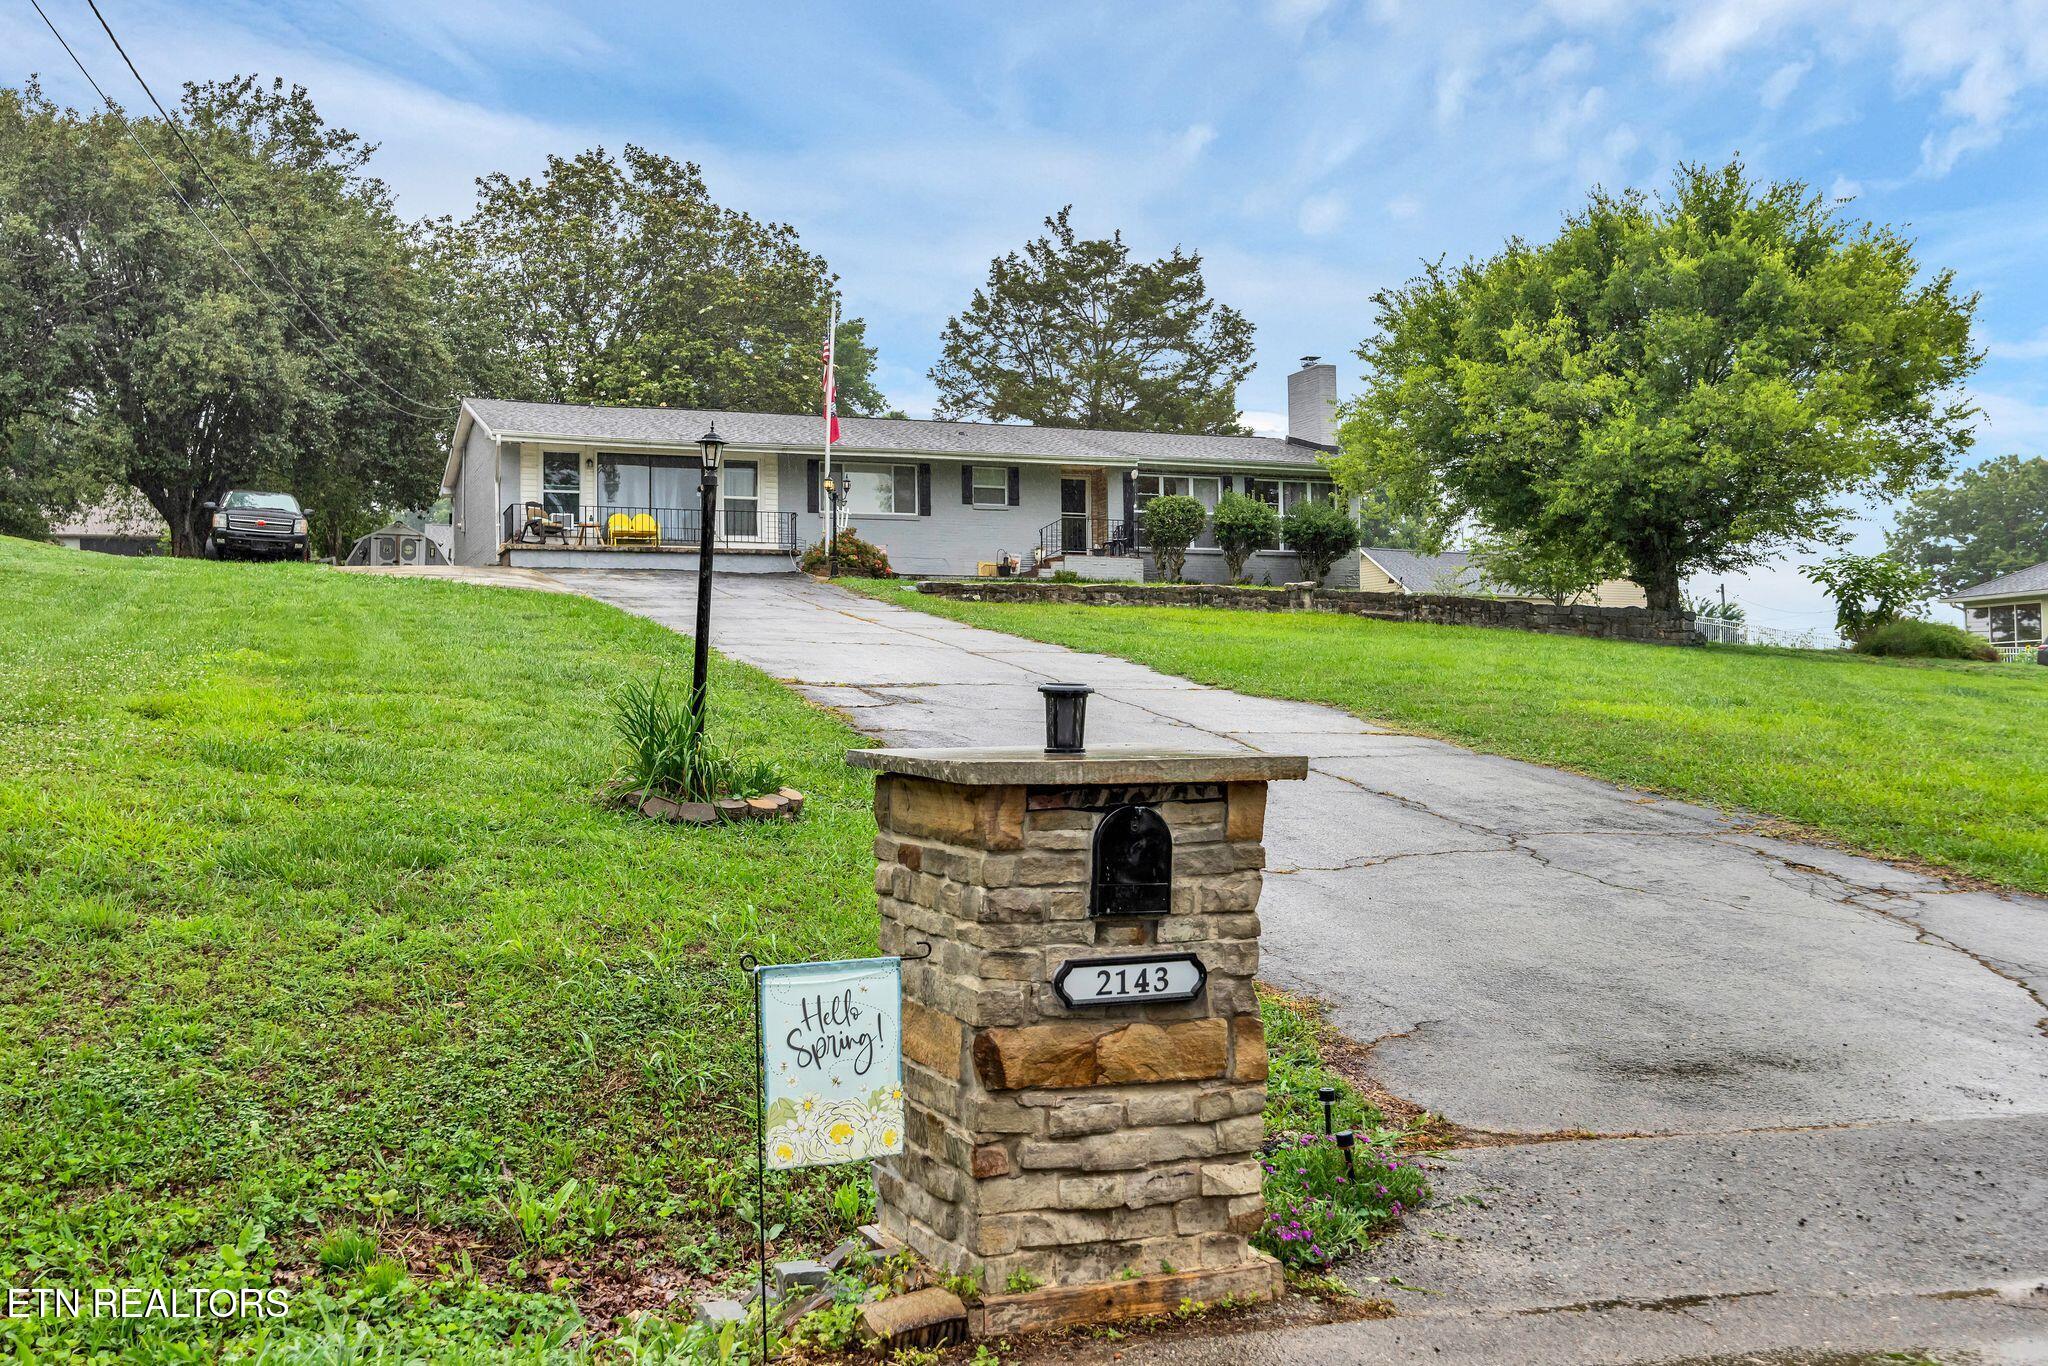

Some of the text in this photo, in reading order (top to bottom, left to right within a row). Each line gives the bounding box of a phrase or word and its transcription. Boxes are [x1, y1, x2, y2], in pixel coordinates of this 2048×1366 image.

[1096, 967, 1169, 996] 2143
[801, 989, 862, 1034] Hello
[787, 1013, 884, 1075] Spring!
